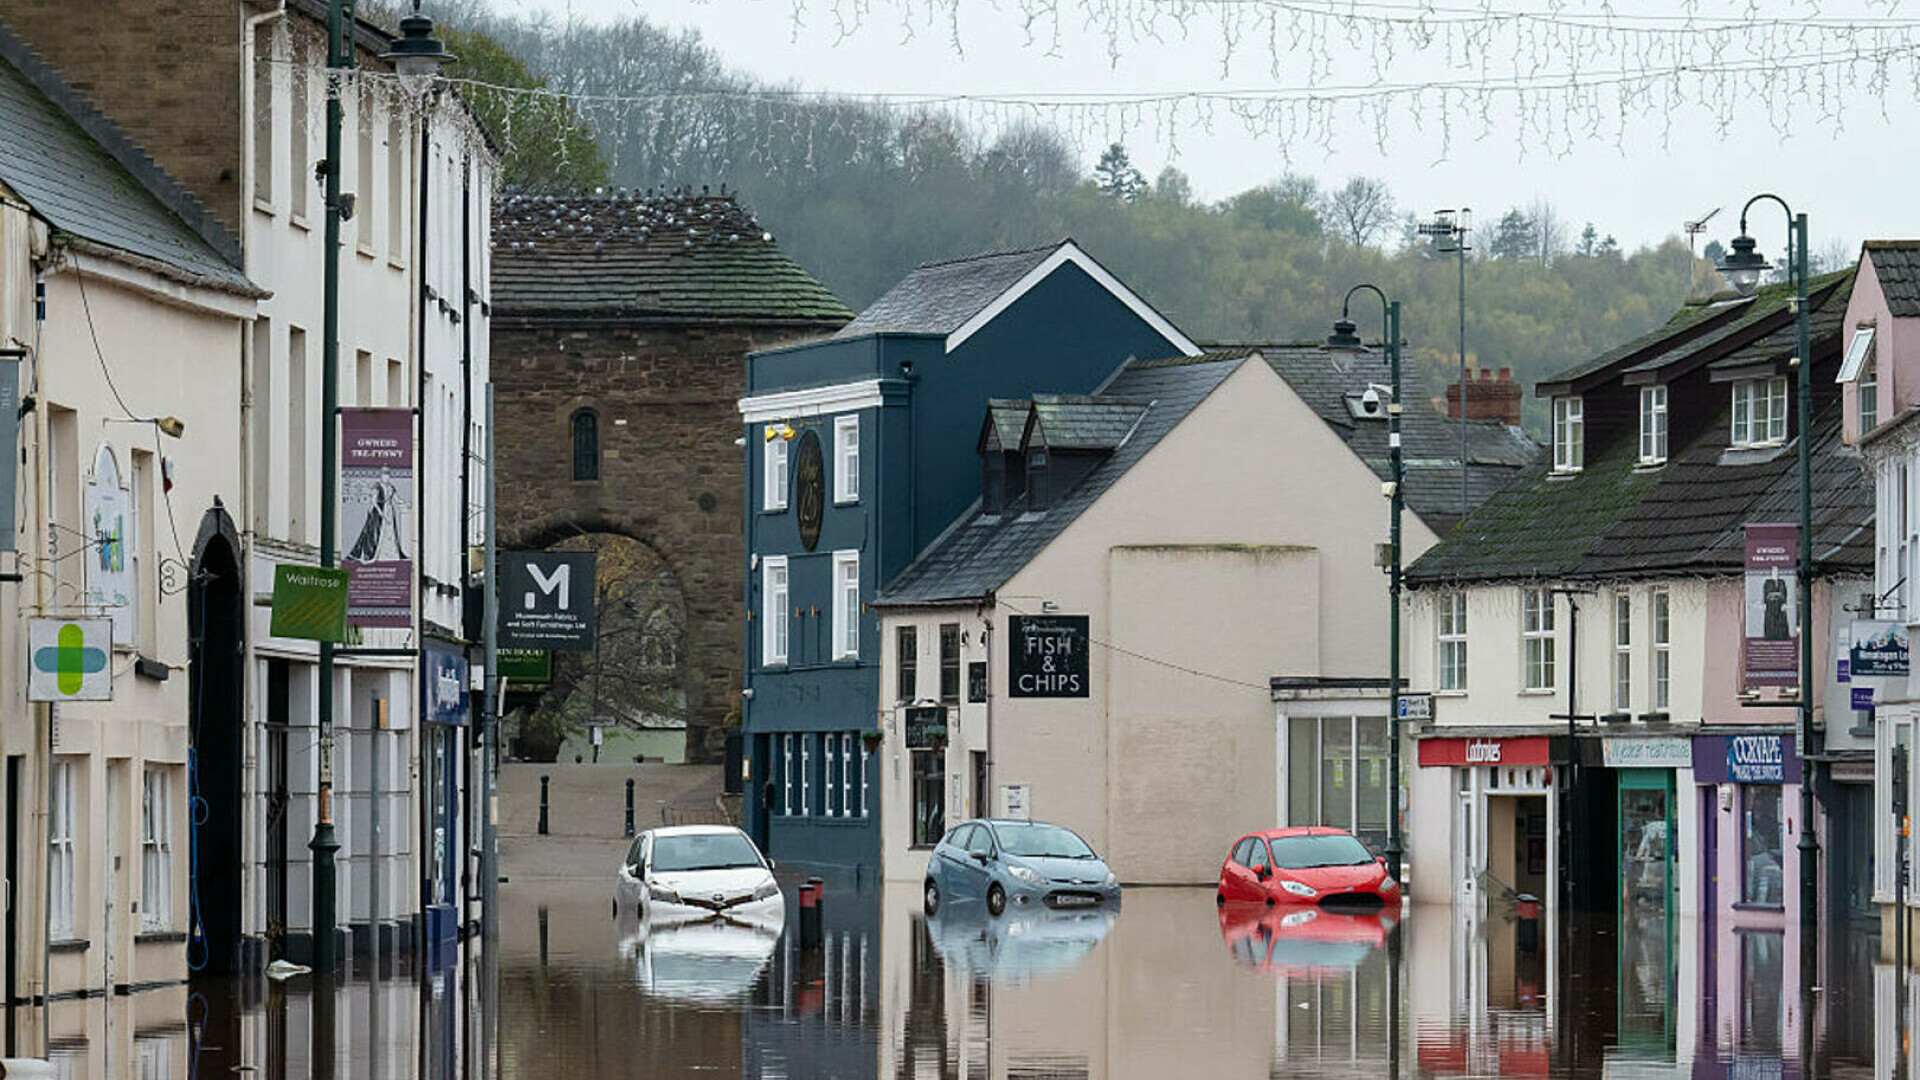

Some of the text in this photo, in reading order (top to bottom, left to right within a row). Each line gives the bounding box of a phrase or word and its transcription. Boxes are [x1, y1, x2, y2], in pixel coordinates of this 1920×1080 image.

[286, 572, 340, 588] Waitrose
[524, 563, 569, 610] M
[1027, 636, 1071, 655] FISH
[1042, 655, 1056, 673] &
[1018, 674, 1080, 693] CHIPS
